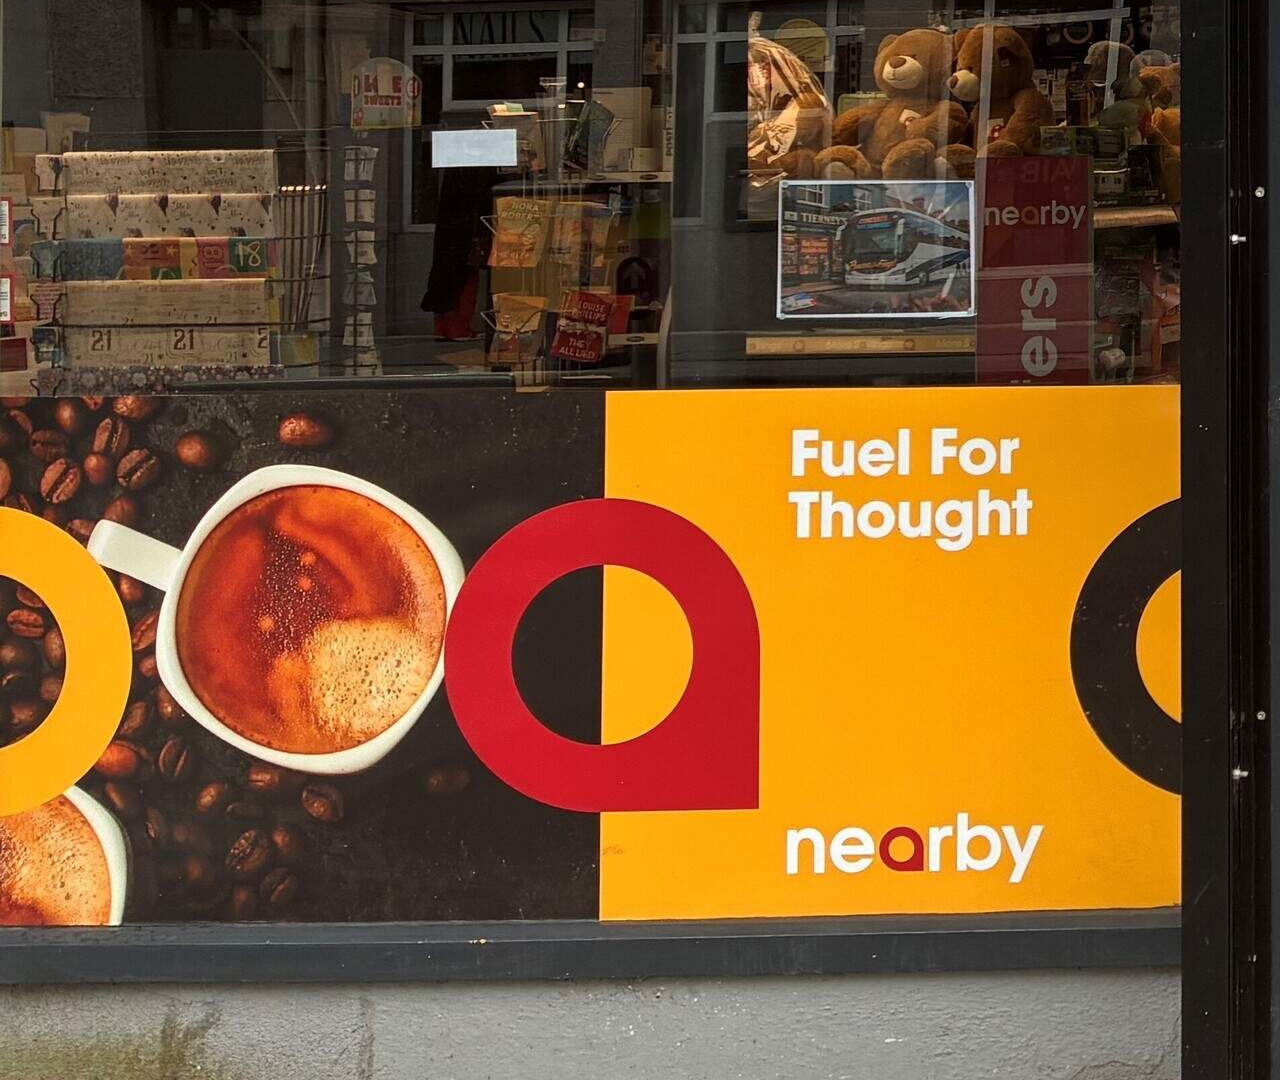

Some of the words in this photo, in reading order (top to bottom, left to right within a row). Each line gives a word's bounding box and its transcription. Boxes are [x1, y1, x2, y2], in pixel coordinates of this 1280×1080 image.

[984, 199, 1087, 230] nearby
[238, 239, 261, 267] 18
[91, 329, 112, 352] 21
[173, 328, 195, 351] 21
[1016, 276, 1058, 382] ers
[791, 428, 913, 478] Fuel
[932, 428, 1020, 477] For
[789, 487, 1034, 553] Thought
[786, 813, 1044, 884] nearby
